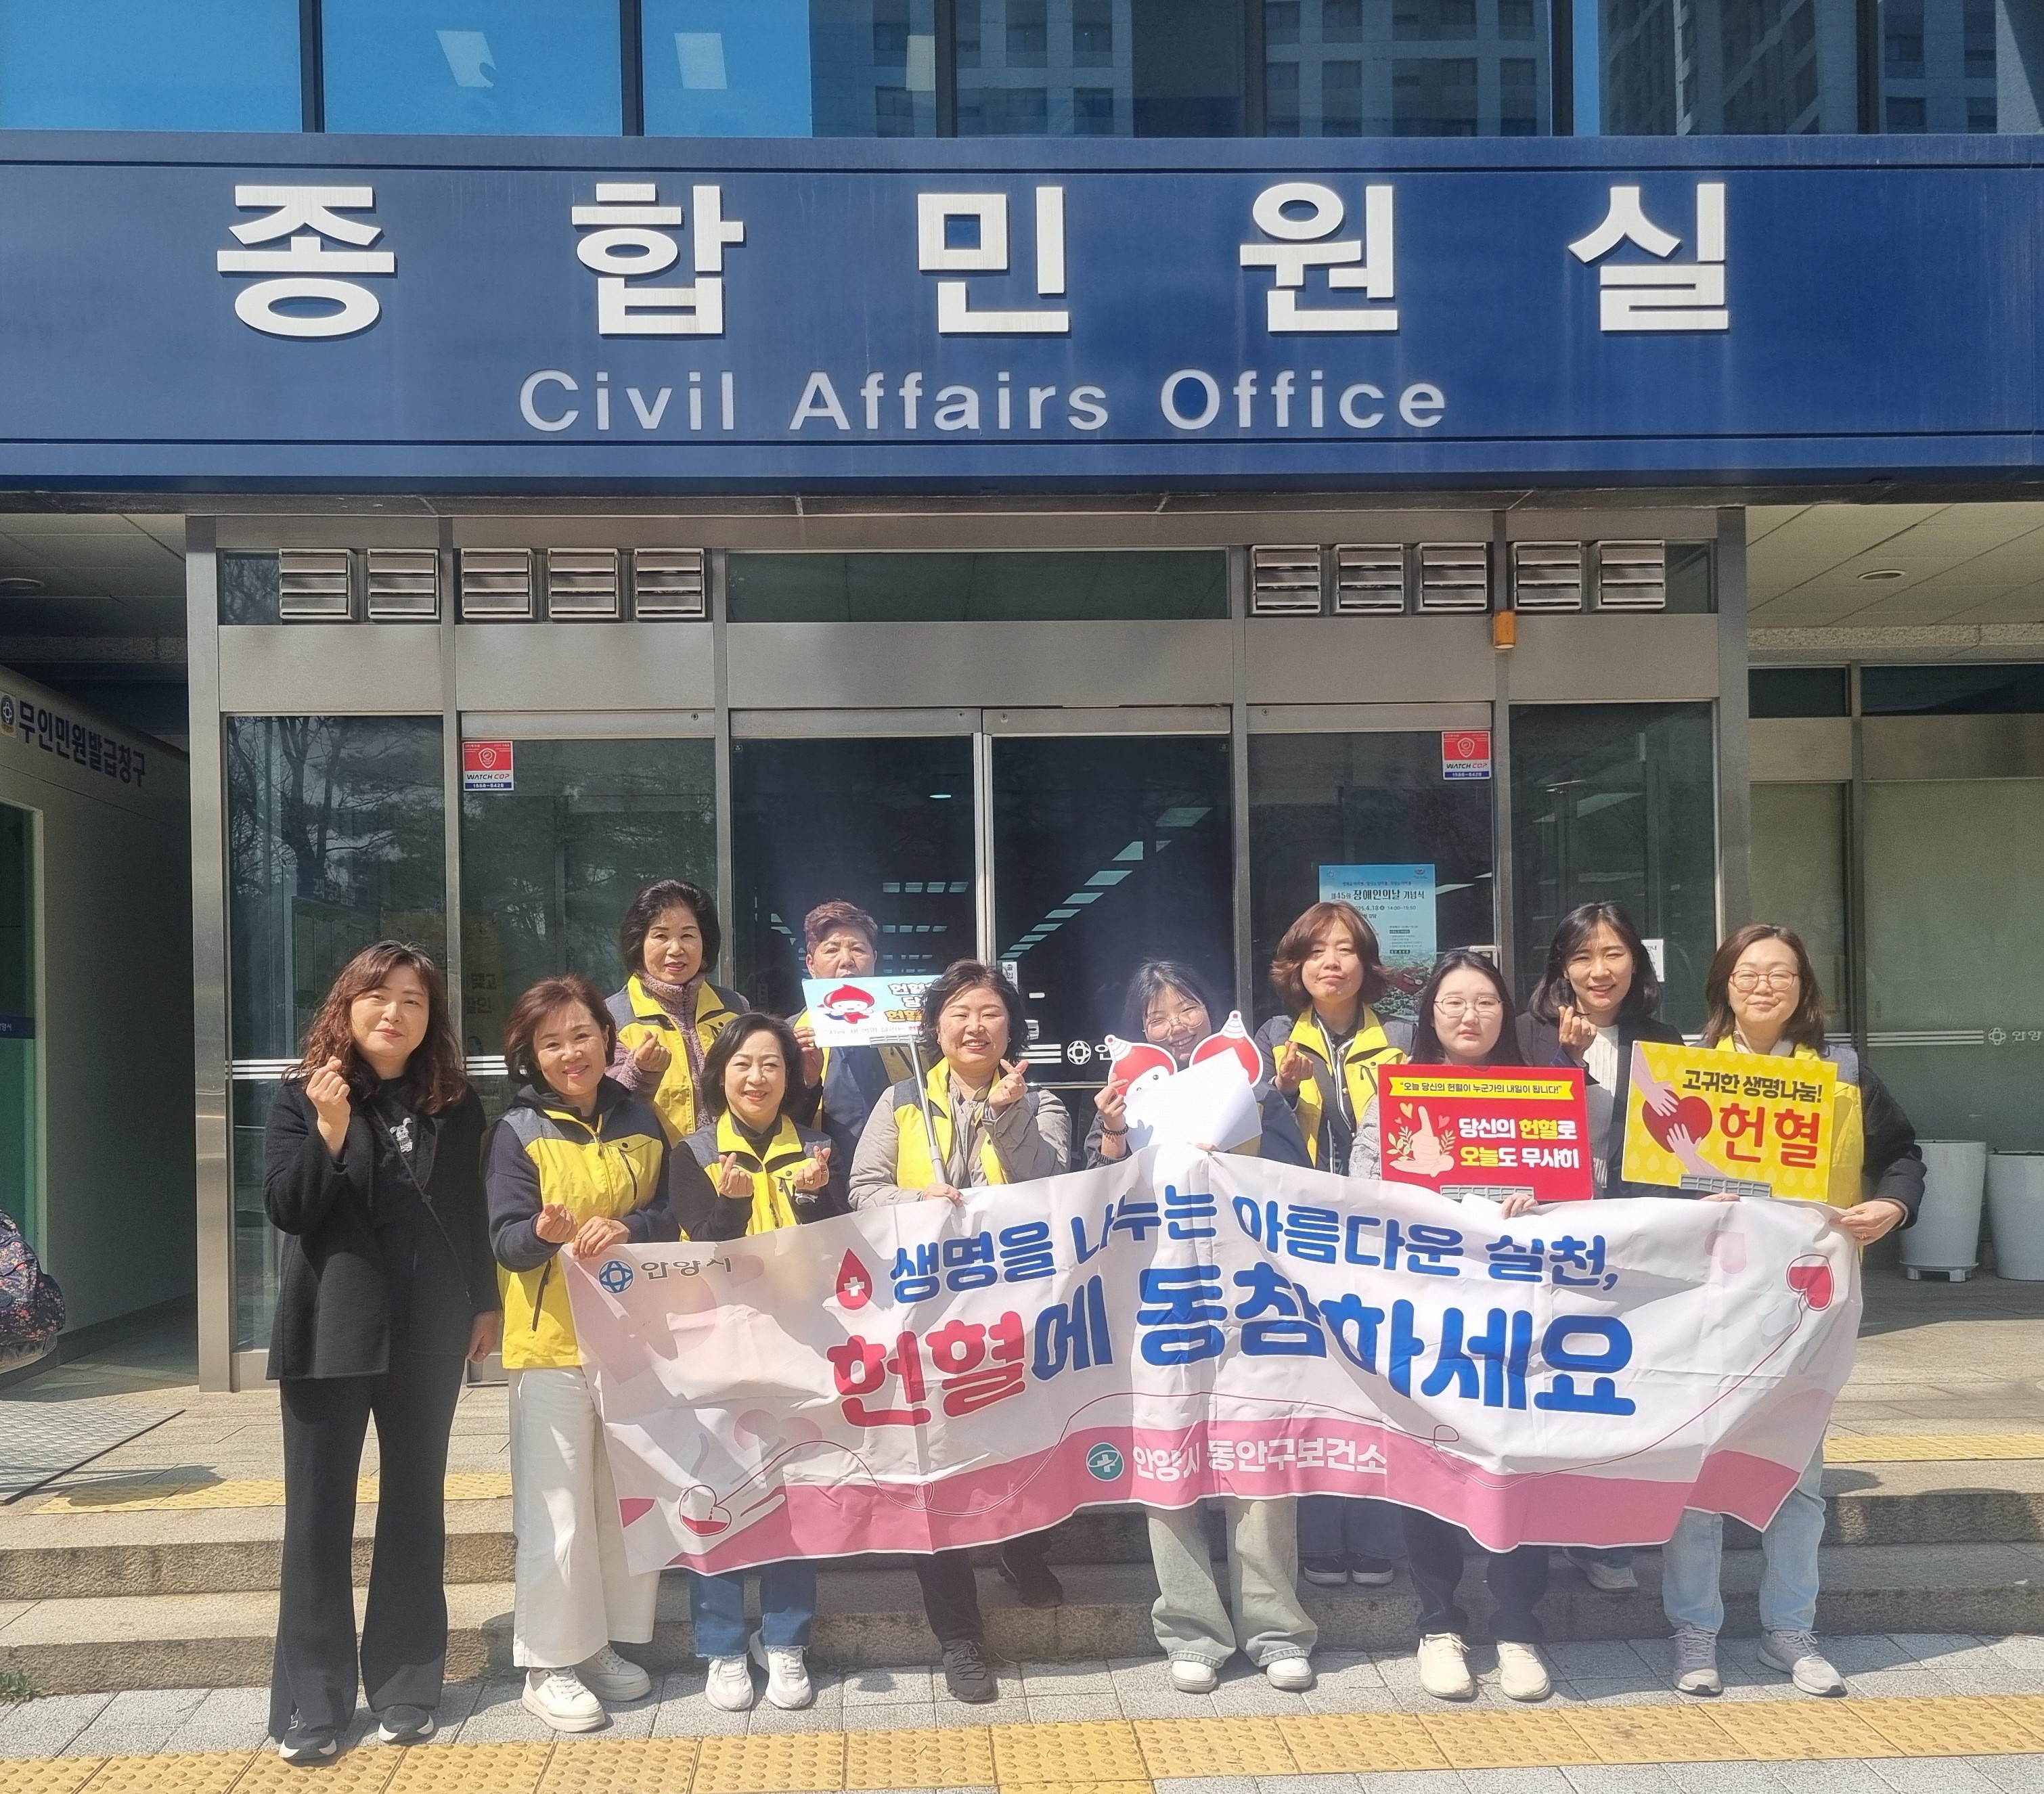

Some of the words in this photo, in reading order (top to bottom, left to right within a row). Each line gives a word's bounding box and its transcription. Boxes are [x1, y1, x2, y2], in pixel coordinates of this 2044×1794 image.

[217, 183, 1727, 336] 종합민원실
[520, 371, 733, 431] Civil
[791, 373, 1107, 430] Affairs
[1161, 370, 1444, 429] Office
[19, 700, 146, 788] 무인민원발급창구
[1353, 889, 1400, 900] 장애인의날
[1403, 890, 1425, 899] 기념식
[888, 983, 933, 995] 헌혈
[2012, 1030, 2044, 1043] 안양
[1421, 1082, 1445, 1092] 당신의
[1447, 1083, 1471, 1092] 헌혈이
[1473, 1083, 1505, 1093] 누군가의
[1507, 1084, 1530, 1094] 내일이
[1682, 1069, 1740, 1095] 고귀한
[1742, 1075, 1823, 1103] 생명나눔!
[1459, 1118, 1516, 1139] 당신의
[1519, 1118, 1578, 1140] 헌혈로
[1719, 1102, 1820, 1169] 헌혈
[1460, 1146, 1518, 1167] 오늘도
[1521, 1146, 1580, 1169] 무사히
[890, 1220, 1057, 1303] 생명을
[1071, 1185, 1218, 1259] 나누는
[1232, 1195, 1465, 1277] 아름다운
[1486, 1234, 1618, 1291] 실천,
[641, 1257, 732, 1280] 안양시
[827, 1274, 1113, 1428] 헌혈에
[1136, 1260, 1637, 1416] 동참하세요
[1132, 1441, 1199, 1482] 안양시
[1206, 1437, 1387, 1475] 동안구보건소
